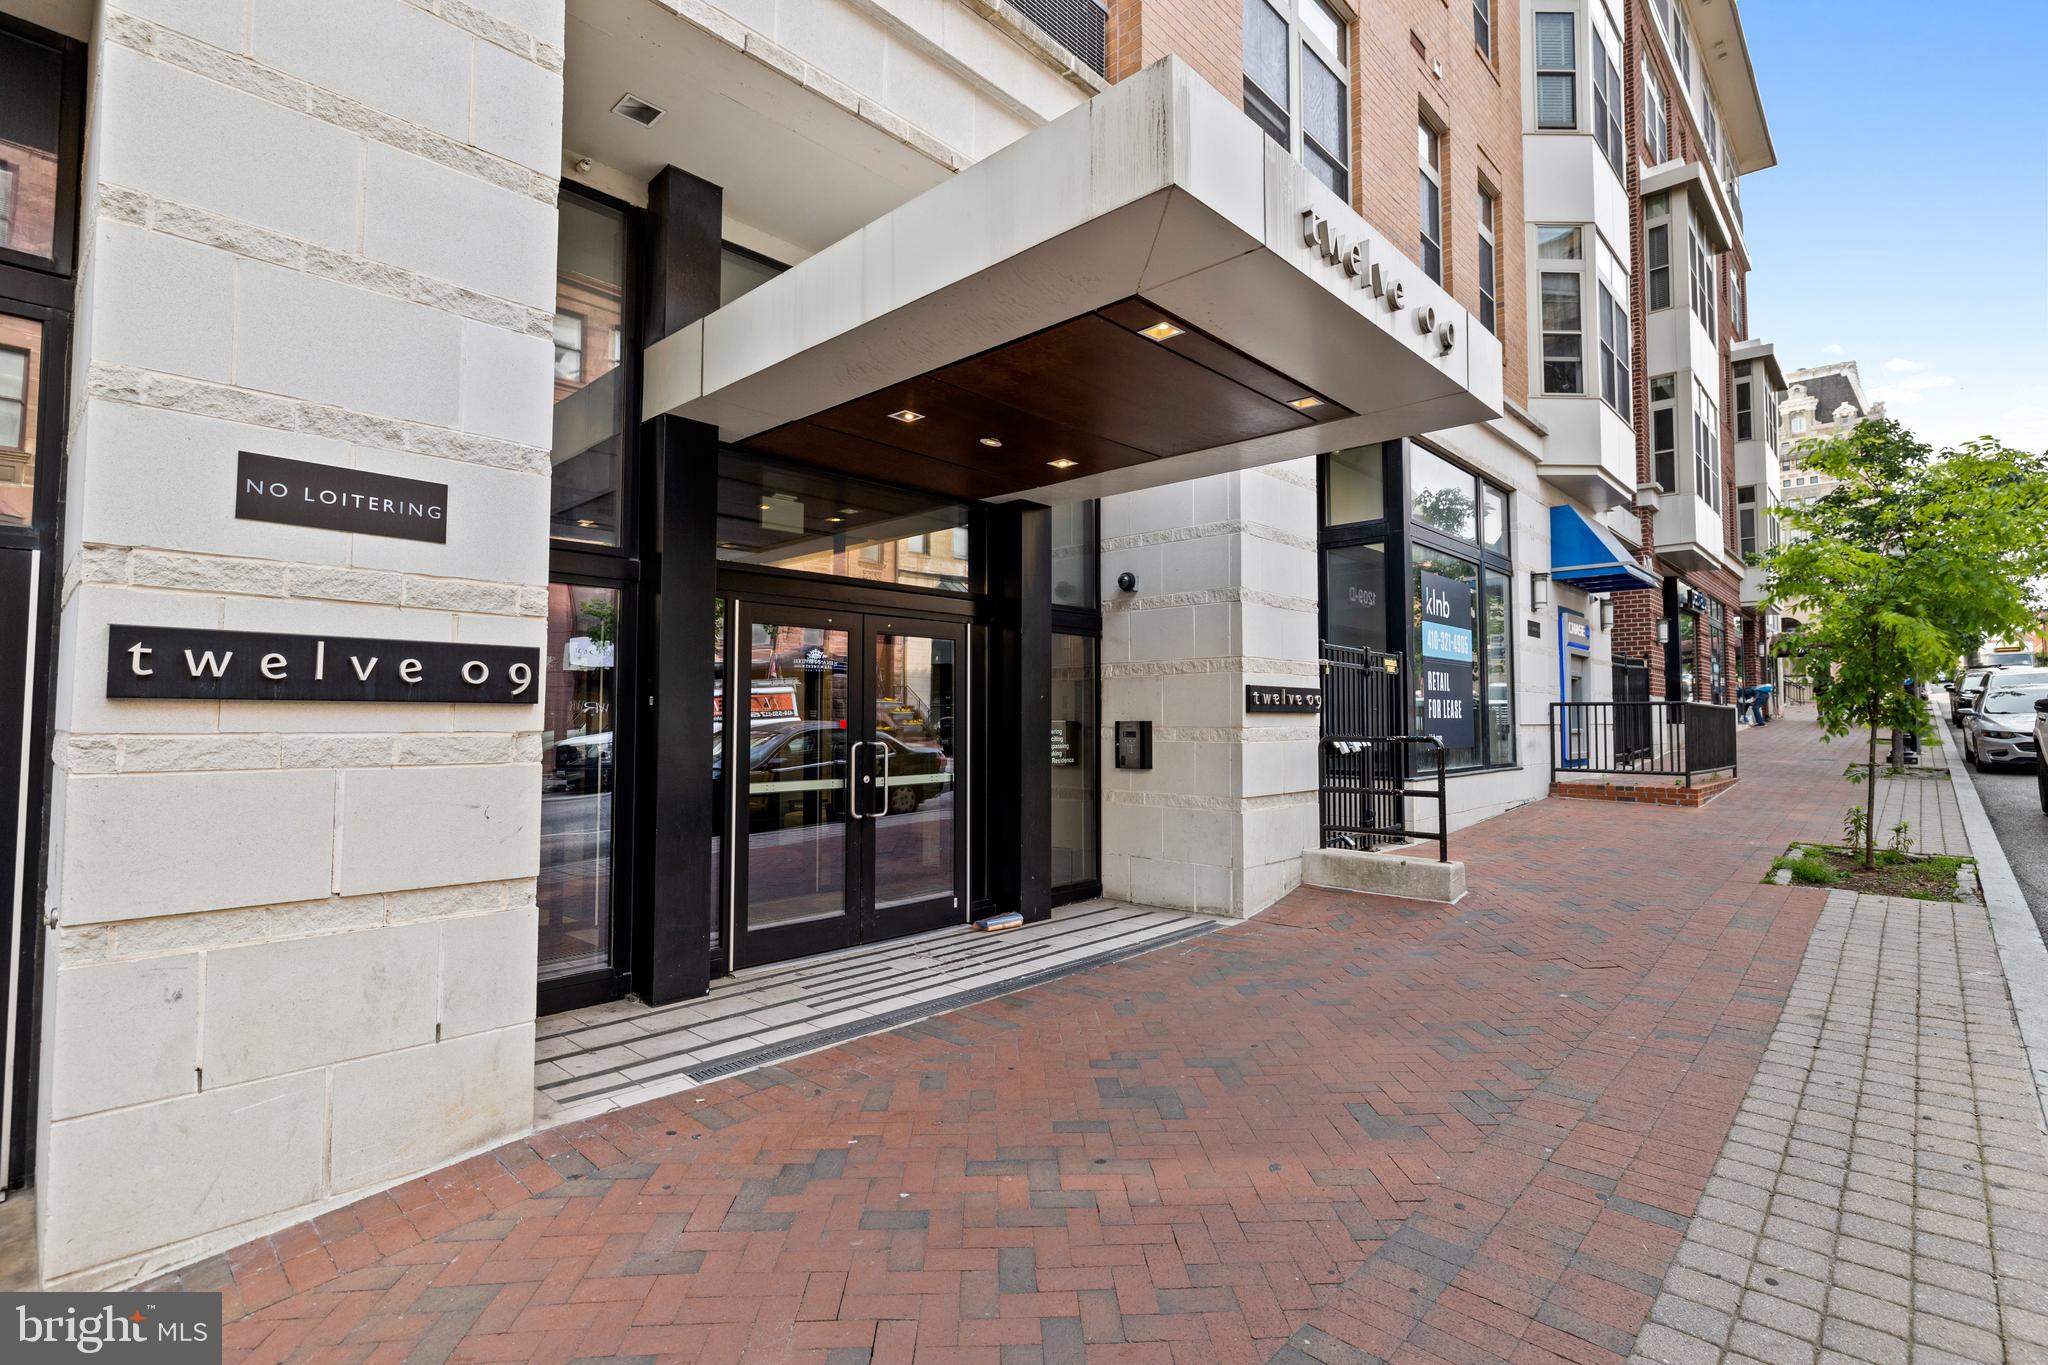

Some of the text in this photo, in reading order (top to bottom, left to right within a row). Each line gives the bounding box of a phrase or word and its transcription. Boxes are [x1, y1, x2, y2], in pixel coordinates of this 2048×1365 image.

[1301, 209, 1405, 312] twelve
[246, 478, 442, 520] NO LOITERING
[1425, 586, 1450, 618] klnb
[1568, 621, 1586, 638] CHASE
[128, 640, 423, 682] twelve
[1427, 670, 1451, 692] RETAIL
[1253, 688, 1303, 705] twelve
[1428, 698, 1463, 719] FOR LEASE
